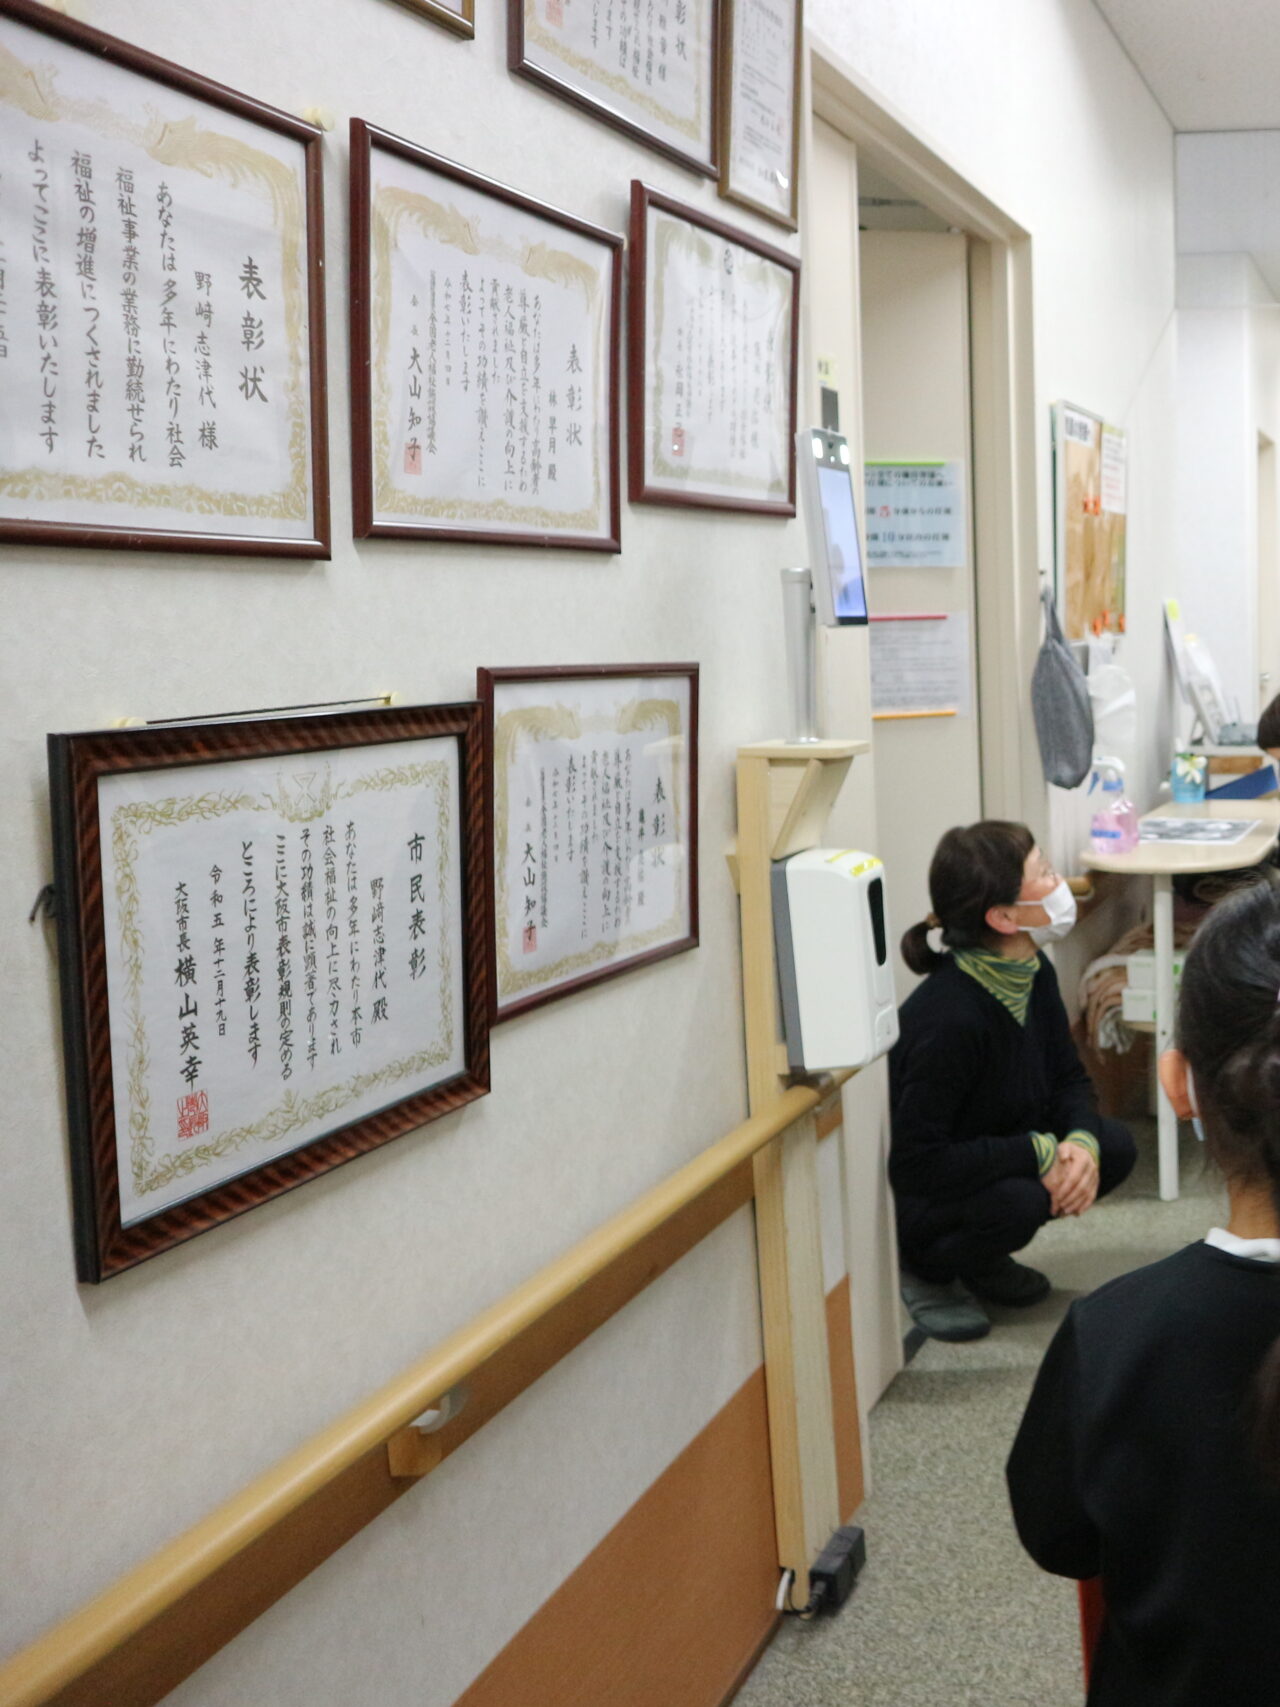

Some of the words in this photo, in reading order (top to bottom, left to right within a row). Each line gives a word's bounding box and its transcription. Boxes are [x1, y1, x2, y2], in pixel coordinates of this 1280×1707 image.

[28, 139, 59, 454] よってここに表彰いたします
[115, 166, 147, 462] 福祉事業の業務に勤続せられ
[238, 256, 269, 402] 表彰状
[566, 344, 583, 447] 表彰状
[242, 841, 262, 1068] ところにより表彰します
[275, 834, 294, 1081] ここに大阪市表彰規則の定める
[322, 825, 341, 1056] 社会福祉の向上に尽力され
[345, 821, 363, 1048] あなたは多年にわたり本市
[407, 833, 426, 981] 市民表彰
